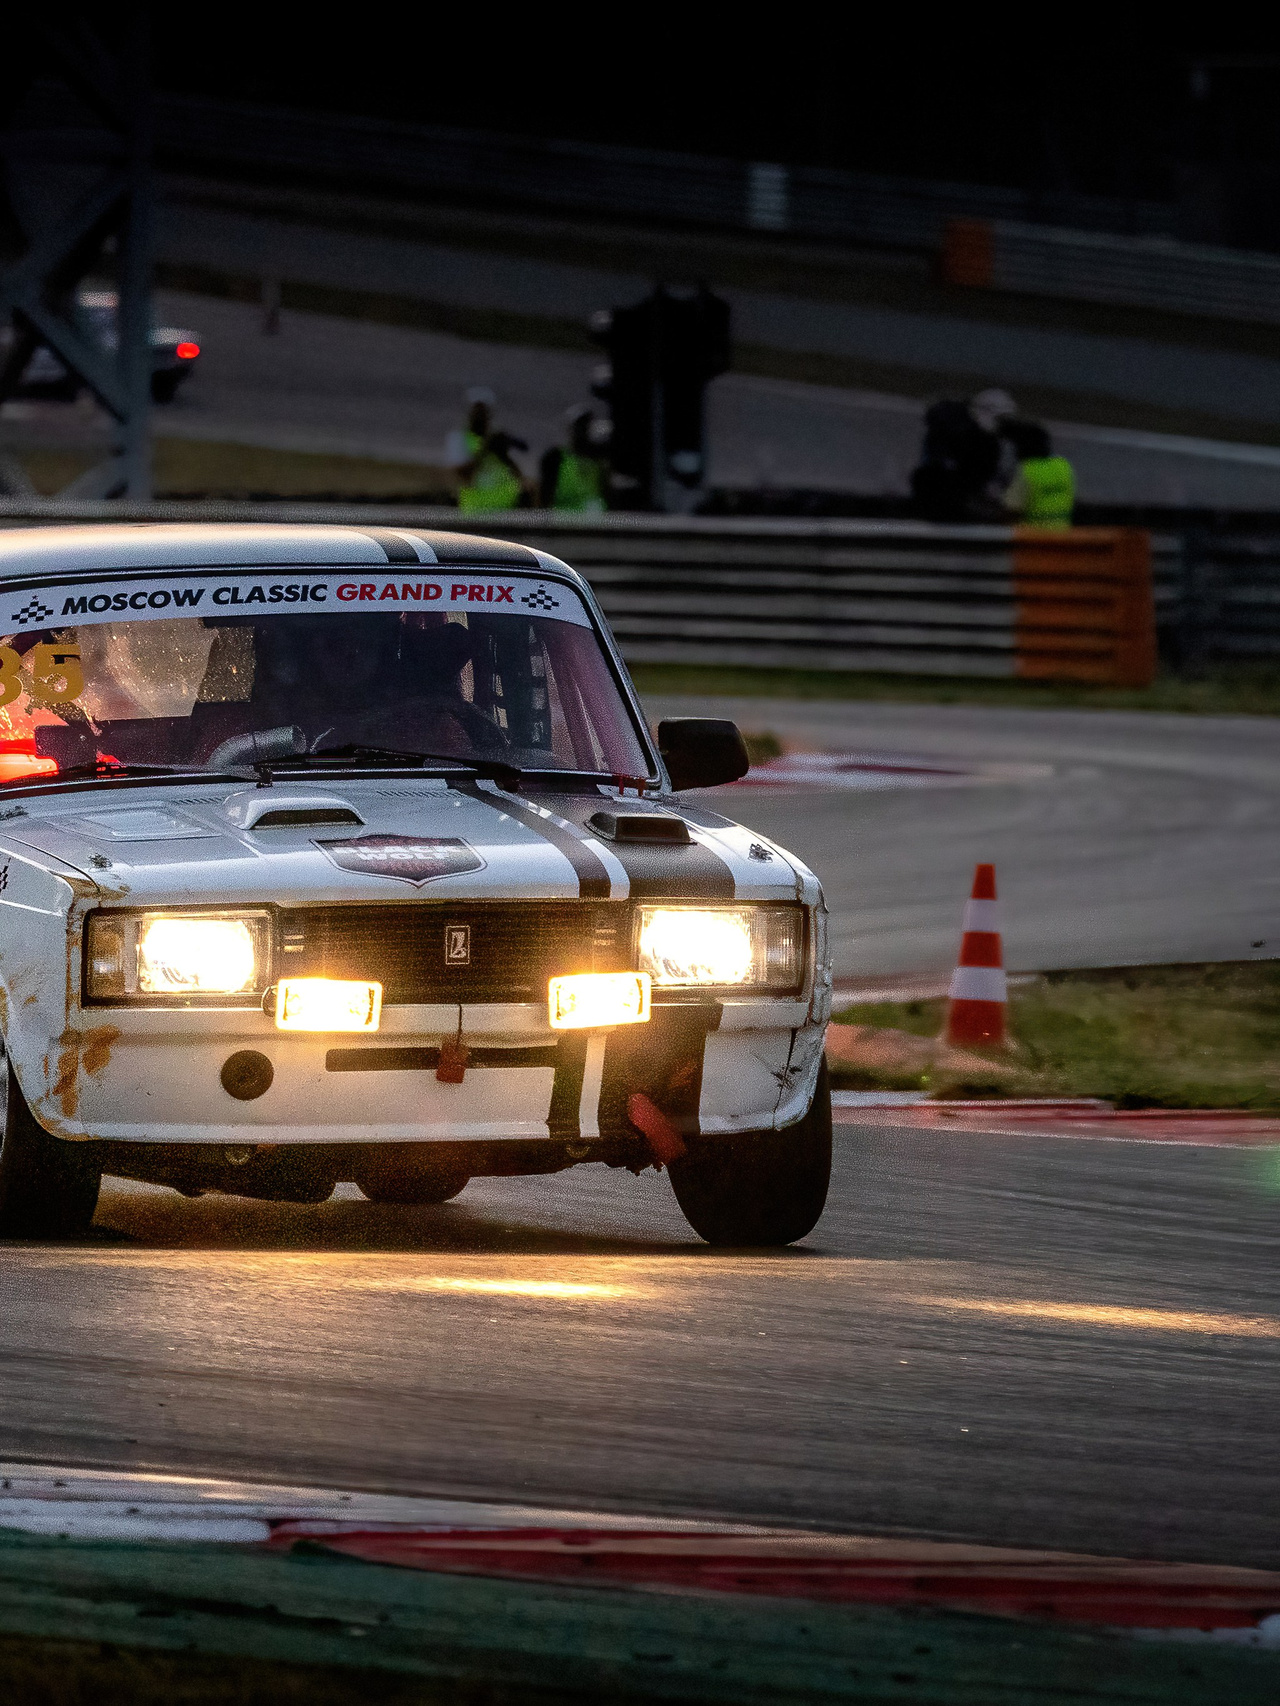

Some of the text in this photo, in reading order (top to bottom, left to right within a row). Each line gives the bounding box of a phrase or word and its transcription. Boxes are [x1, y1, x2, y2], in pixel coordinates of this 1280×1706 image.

[61, 583, 516, 616] MOSCOW CLASSIC GRAND PRIX
[357, 853, 449, 861] WOLF
